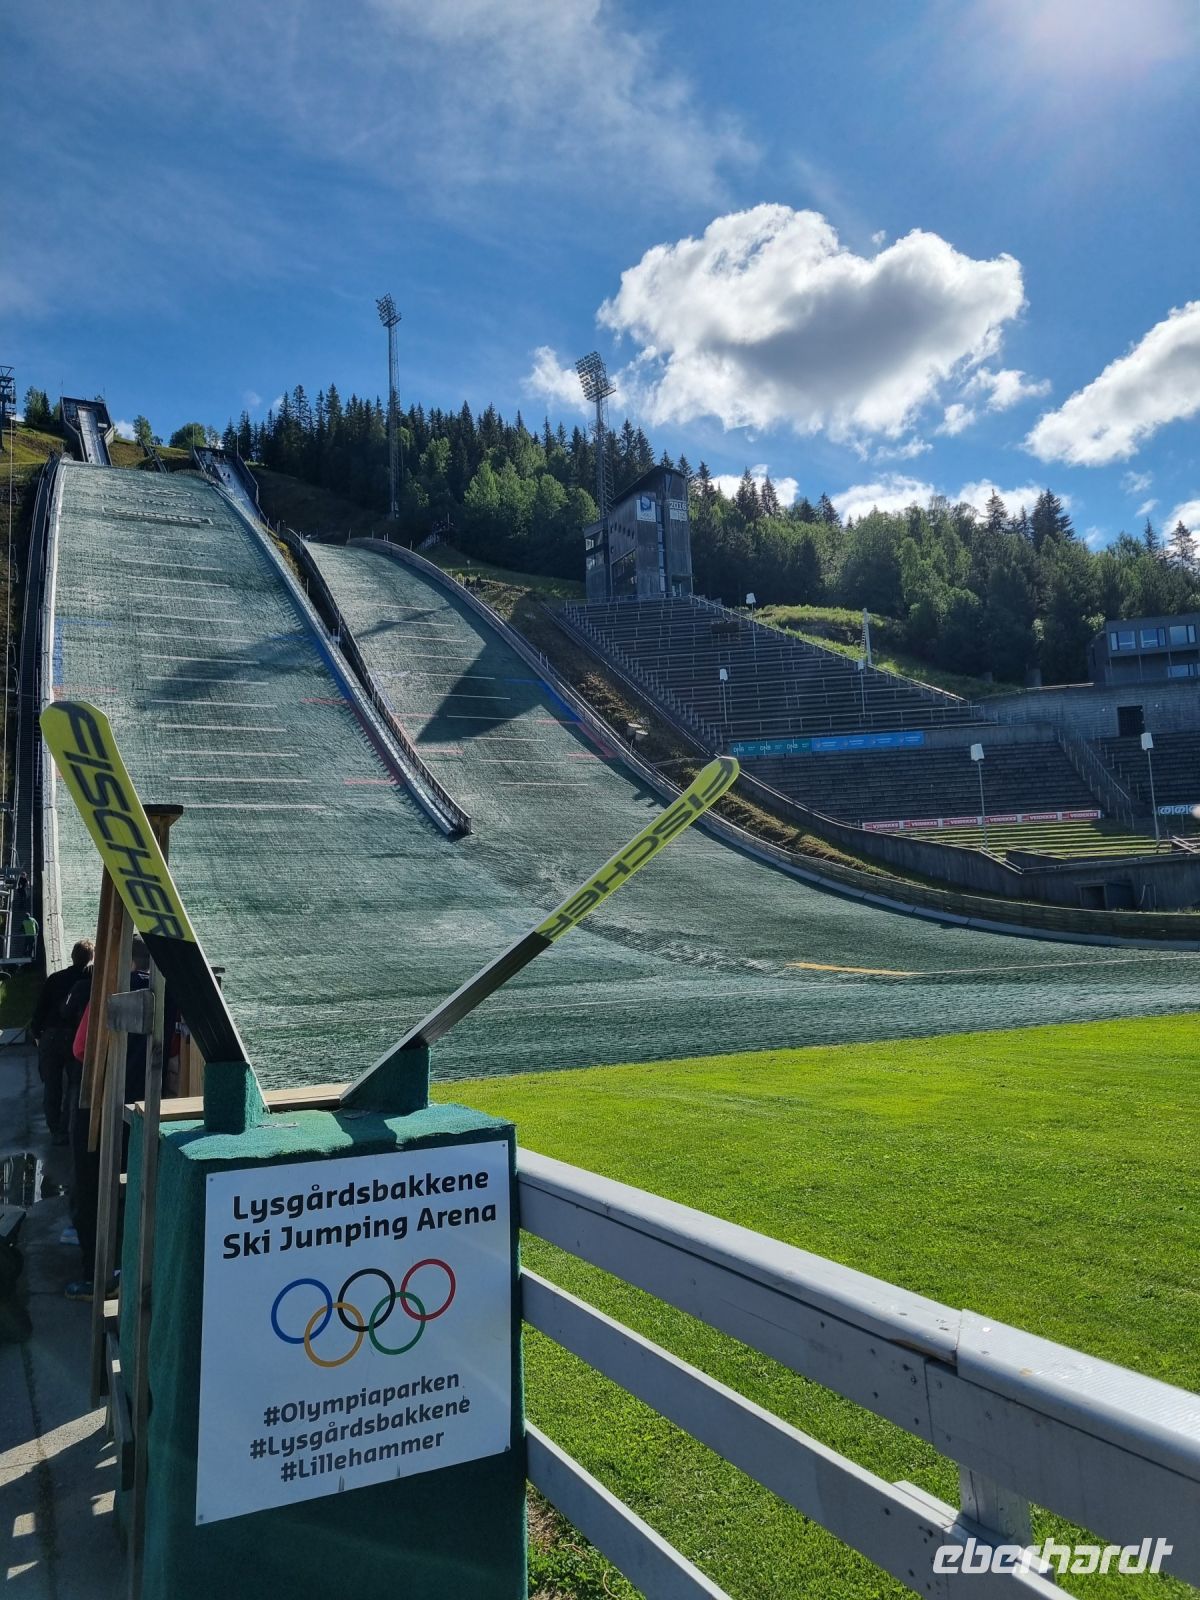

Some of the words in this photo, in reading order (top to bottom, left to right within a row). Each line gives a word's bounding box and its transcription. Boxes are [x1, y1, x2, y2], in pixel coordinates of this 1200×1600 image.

[50, 701, 185, 939] FISCHER
[538, 759, 735, 939] FISCHER
[233, 1171, 489, 1224] Lysgårdsbakkene
[223, 1229, 270, 1259] Ski
[279, 1215, 408, 1251] Jumping
[416, 1204, 497, 1231] Arena
[263, 1373, 459, 1427] #Olympiaparken
[250, 1398, 471, 1459] #Lysgårdsbakkene
[280, 1431, 445, 1482] #Lillehammer
